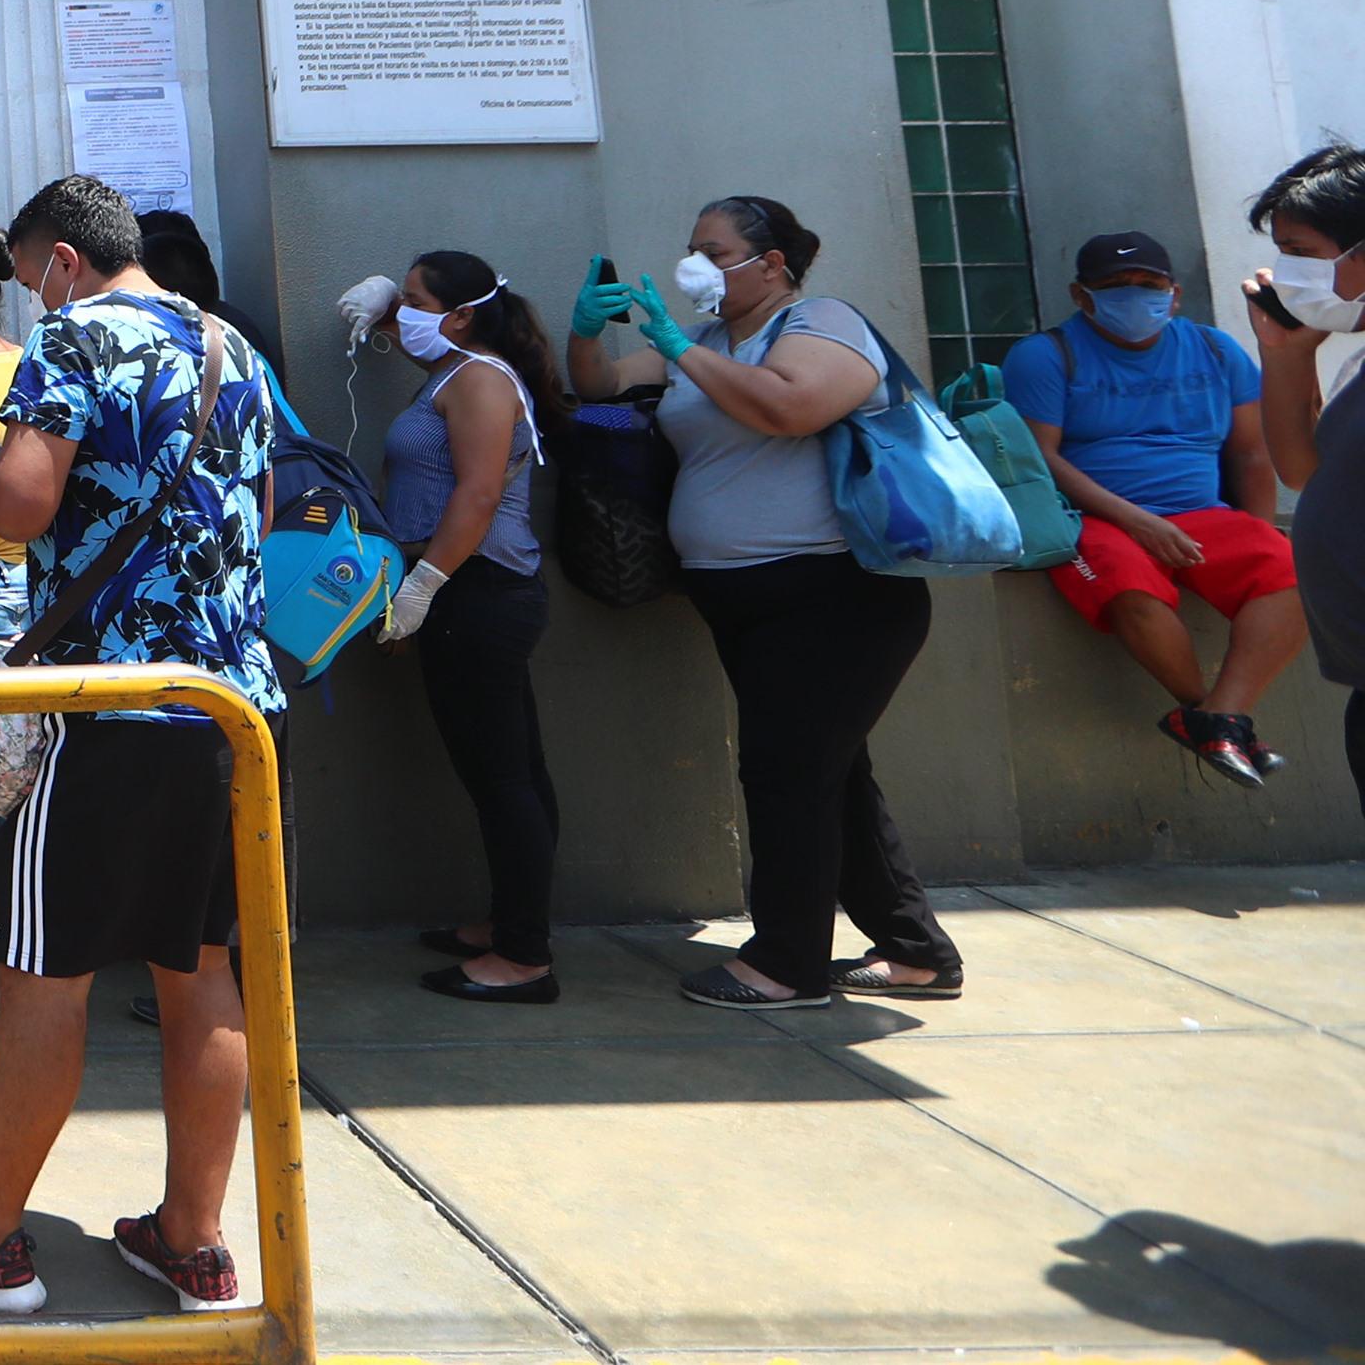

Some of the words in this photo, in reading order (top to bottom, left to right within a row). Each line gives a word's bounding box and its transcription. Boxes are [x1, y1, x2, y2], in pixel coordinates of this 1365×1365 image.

[480, 99, 504, 108] Oficina
[506, 99, 515, 107] de
[516, 99, 573, 107] Comunicaciones
